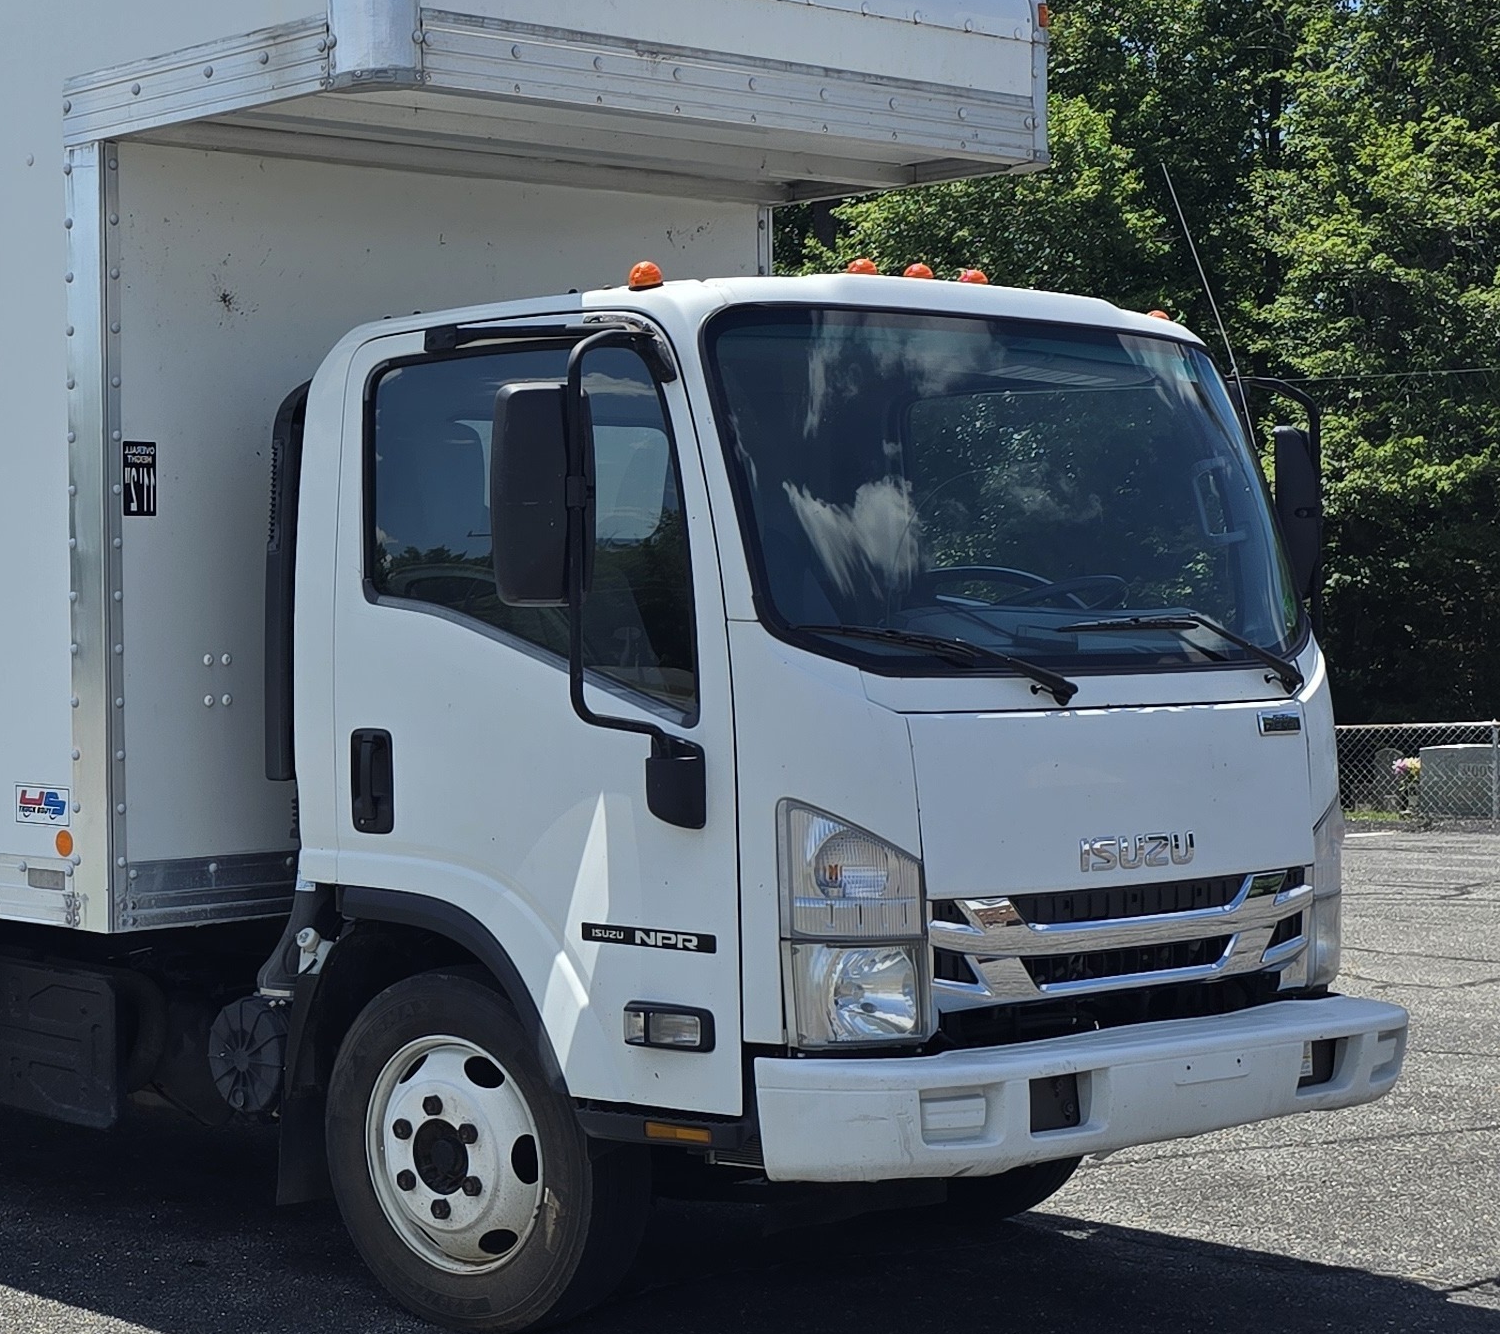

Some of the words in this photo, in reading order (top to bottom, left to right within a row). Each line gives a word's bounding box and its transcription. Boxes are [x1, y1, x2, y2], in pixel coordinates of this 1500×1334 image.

[1079, 830, 1196, 873] ISUZU
[591, 928, 625, 939] ISUZU
[634, 930, 698, 950] NPR
